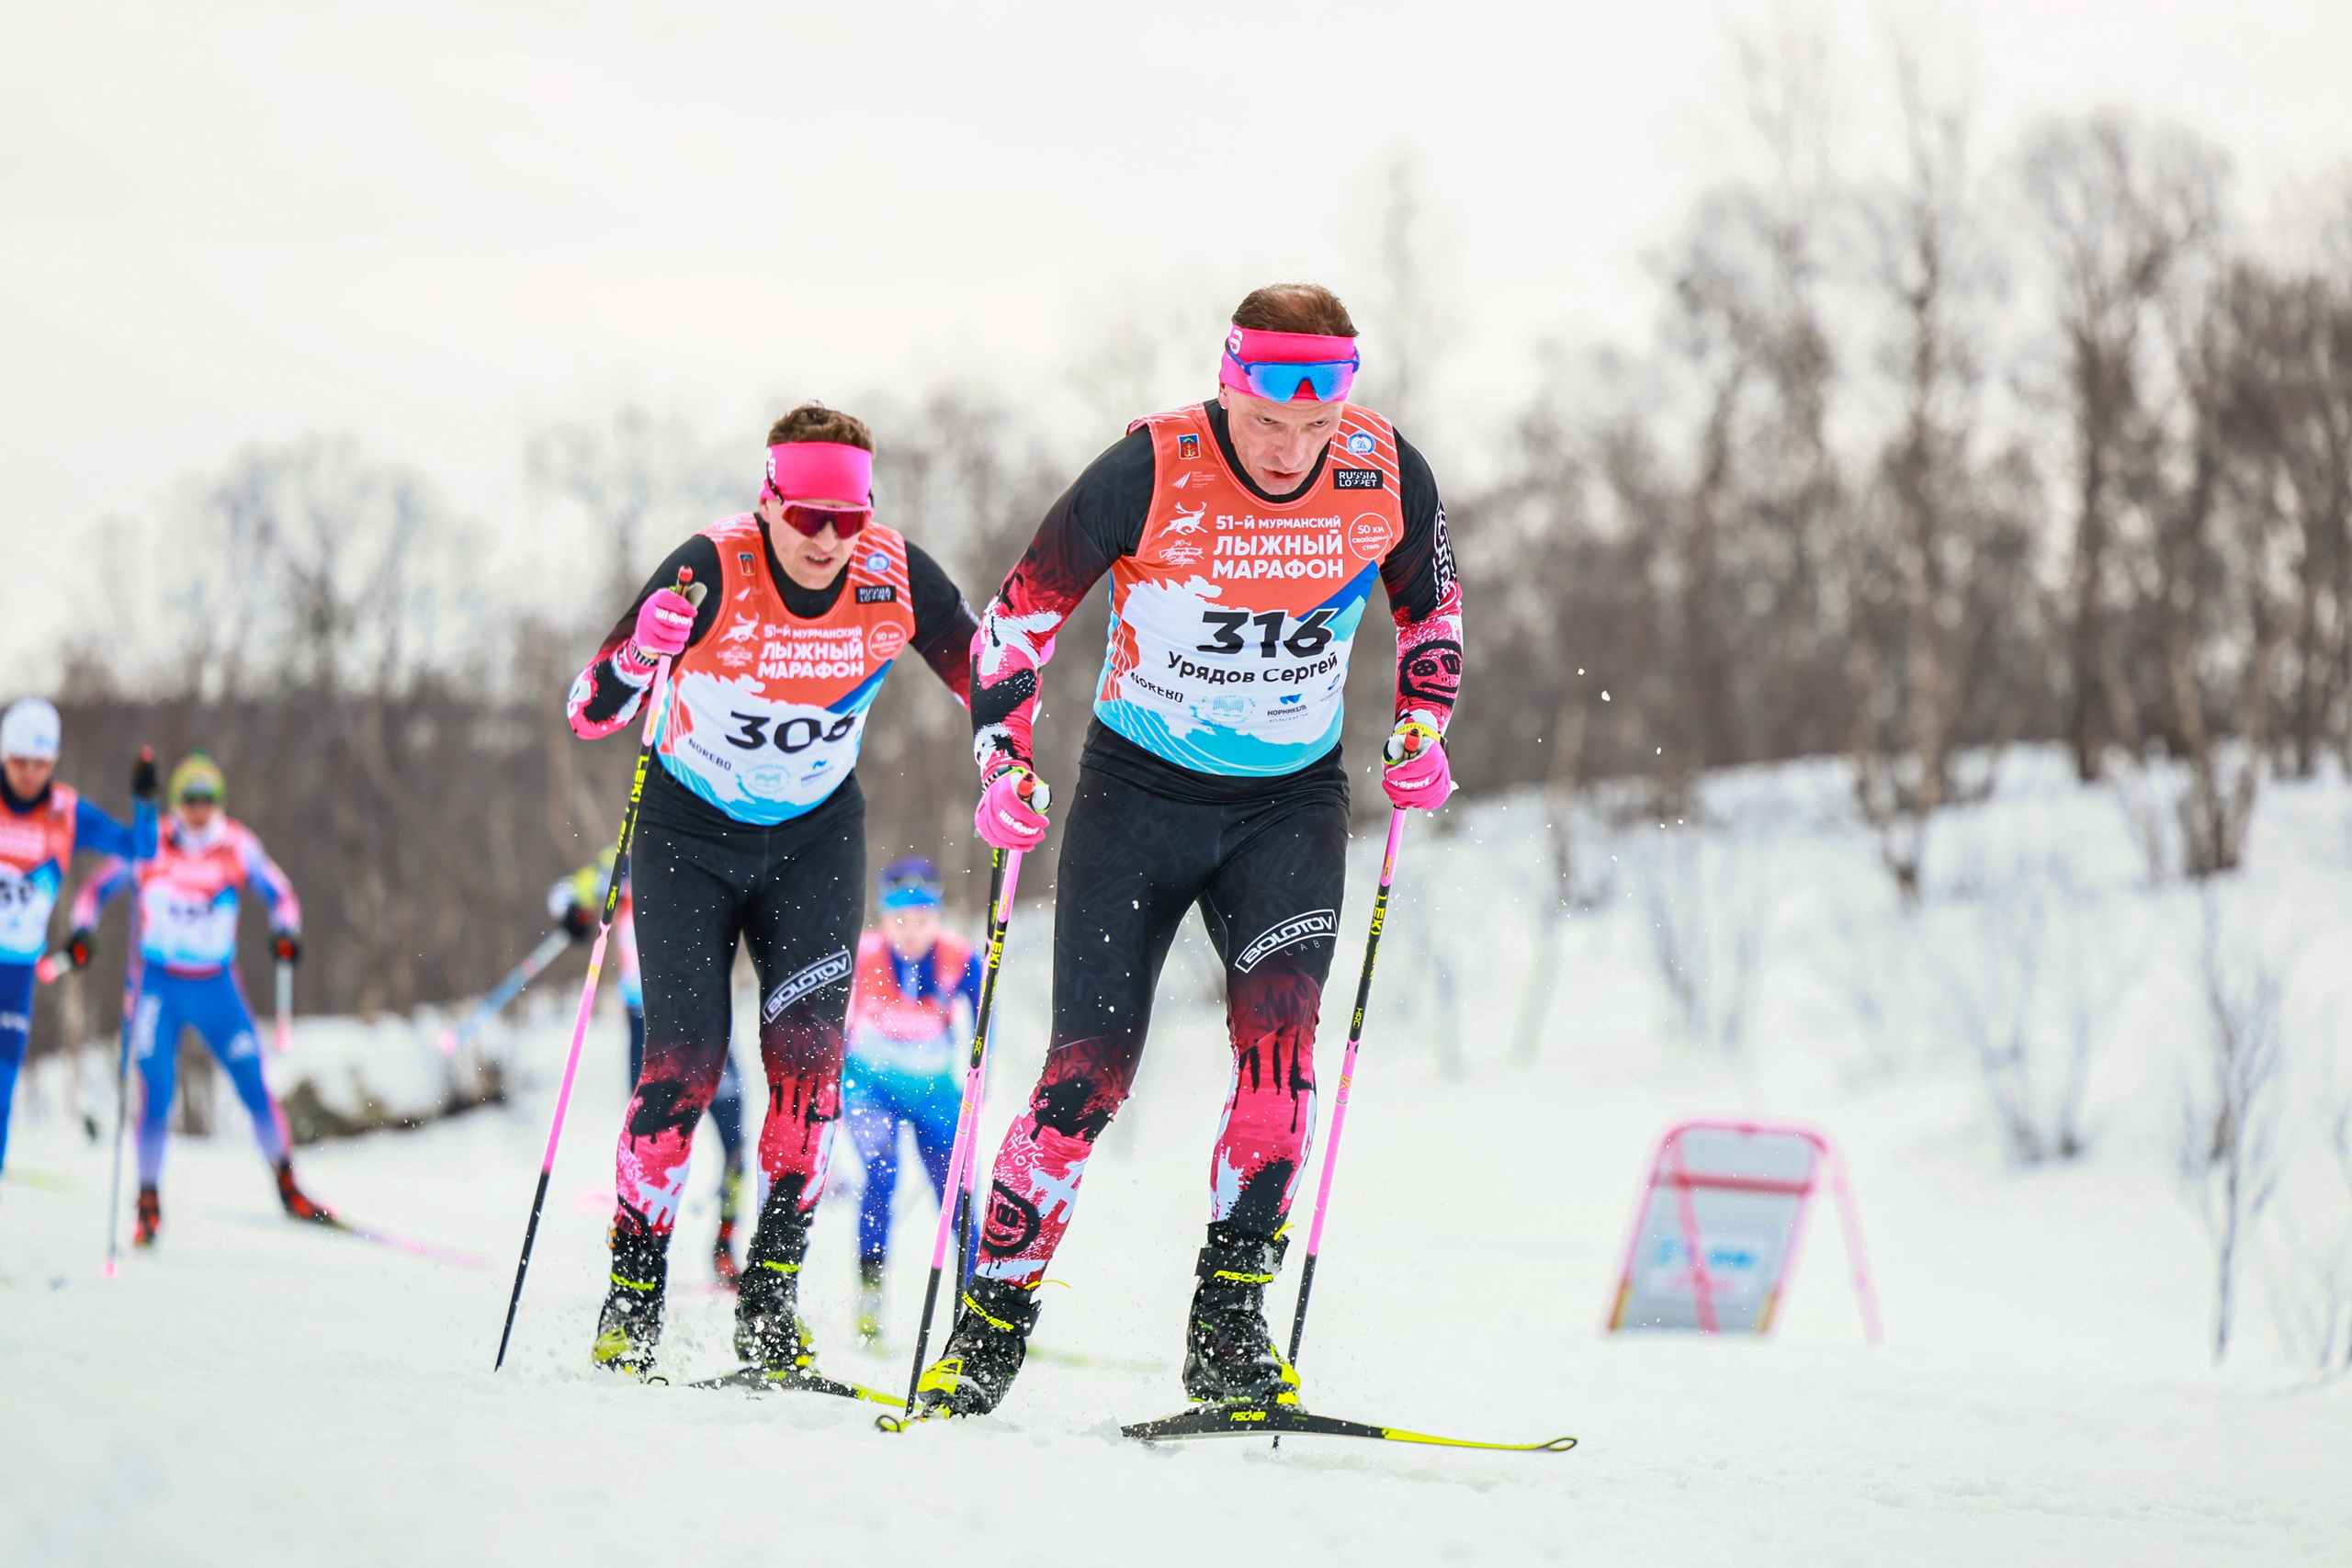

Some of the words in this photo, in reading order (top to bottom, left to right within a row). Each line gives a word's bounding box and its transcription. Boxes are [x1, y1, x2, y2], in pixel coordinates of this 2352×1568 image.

[1258, 515, 1341, 530] МУРМАНСКИЙ
[1357, 525, 1370, 534] 50
[1213, 529, 1344, 556] ЛЫЖНЫЙ
[1211, 558, 1344, 579] МАРАФОН
[792, 625, 863, 639] МУРМАНСКИЙ
[1196, 608, 1340, 659] 316
[760, 638, 865, 660] ЛЫЖНЫЙ
[757, 661, 865, 680] МАРАФОН
[1168, 650, 1255, 686] Урядов
[1263, 651, 1339, 685] Сергей
[689, 738, 731, 771] NOREBO
[630, 755, 650, 803] LEKI
[1370, 894, 1387, 936] LEKI
[989, 930, 1005, 969] LEKI
[1242, 916, 1333, 964] BOLOTOV
[1284, 940, 1320, 957] LAB
[768, 957, 848, 1014] BOLOTOV
[1352, 1007, 1363, 1028] HRC
[973, 1036, 983, 1056] HRC
[1213, 1269, 1274, 1283] FISCHER
[1230, 1411, 1266, 1422] FISCHER
